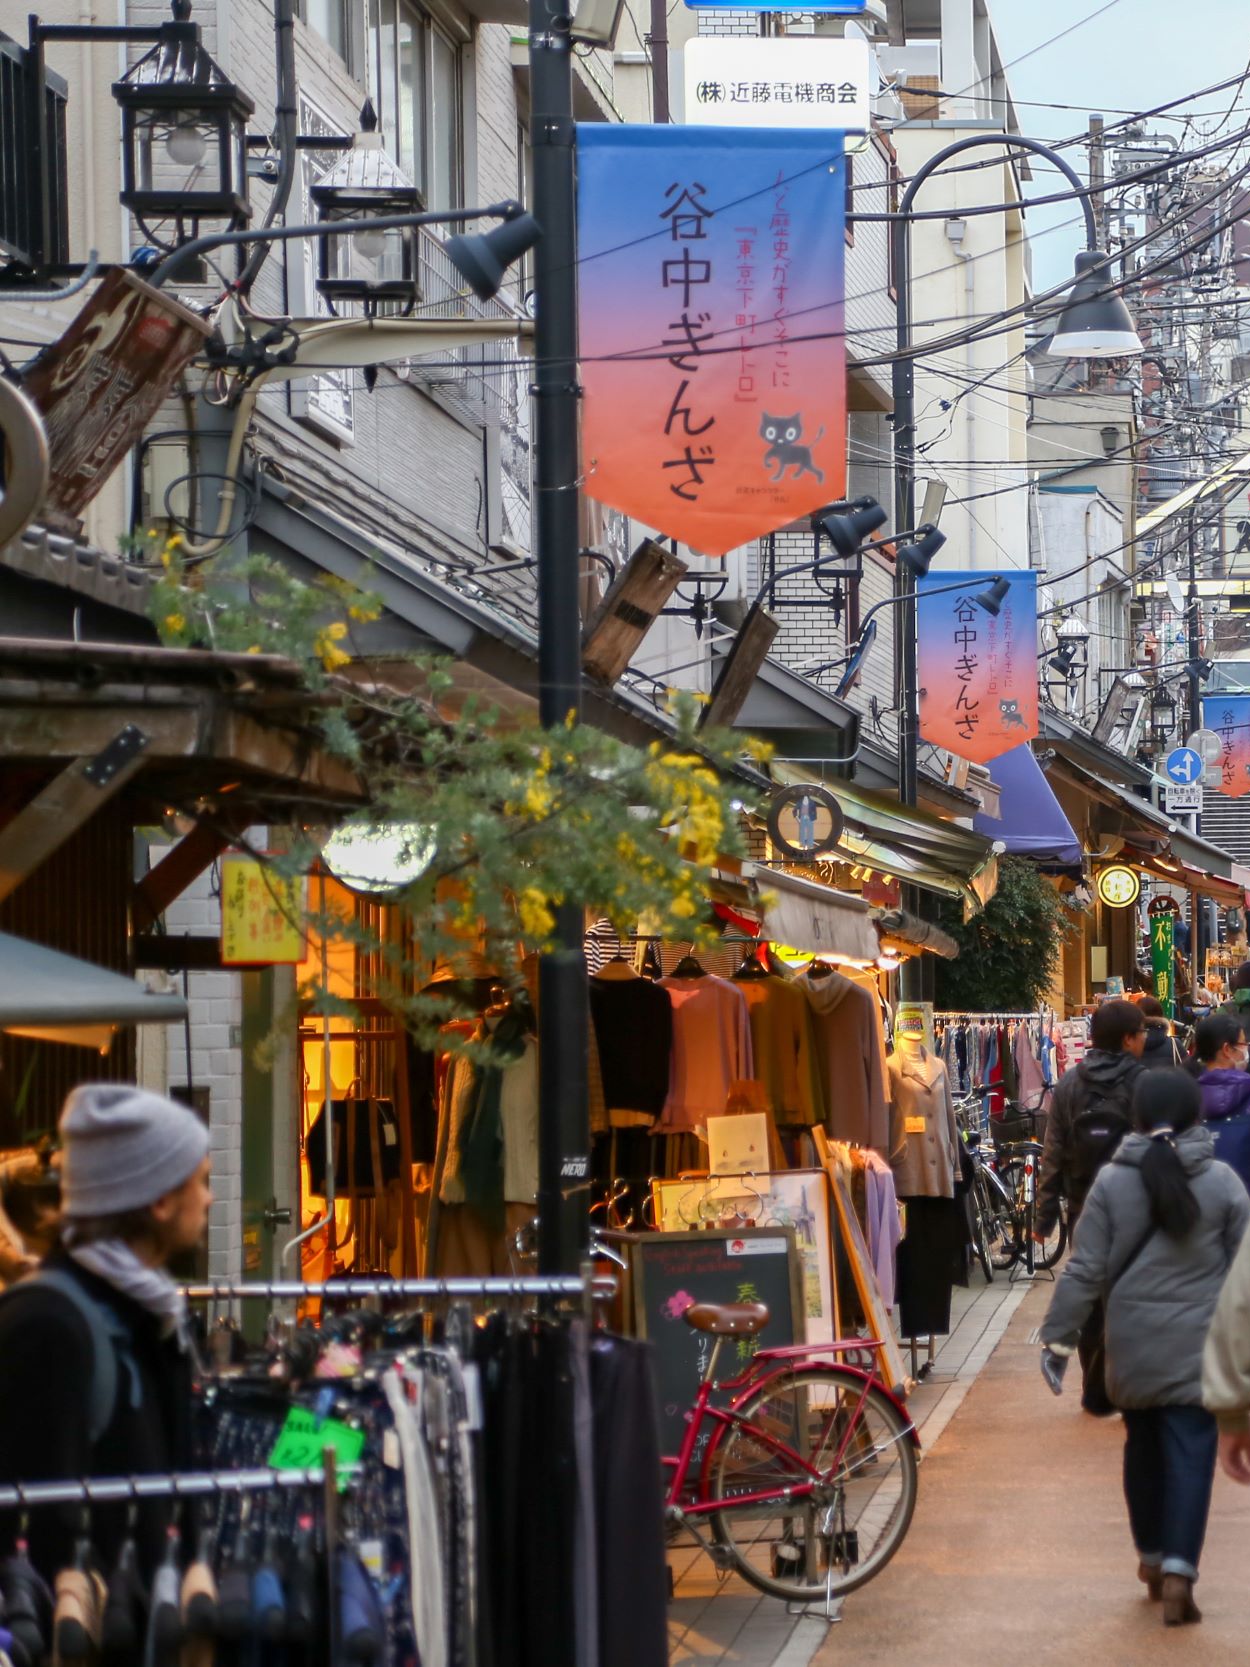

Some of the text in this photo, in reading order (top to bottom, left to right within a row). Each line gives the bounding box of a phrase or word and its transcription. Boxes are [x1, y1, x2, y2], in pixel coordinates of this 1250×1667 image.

[659, 182, 715, 501] 谷中ぎんざ
[953, 596, 979, 740] 谷中ぎんざ
